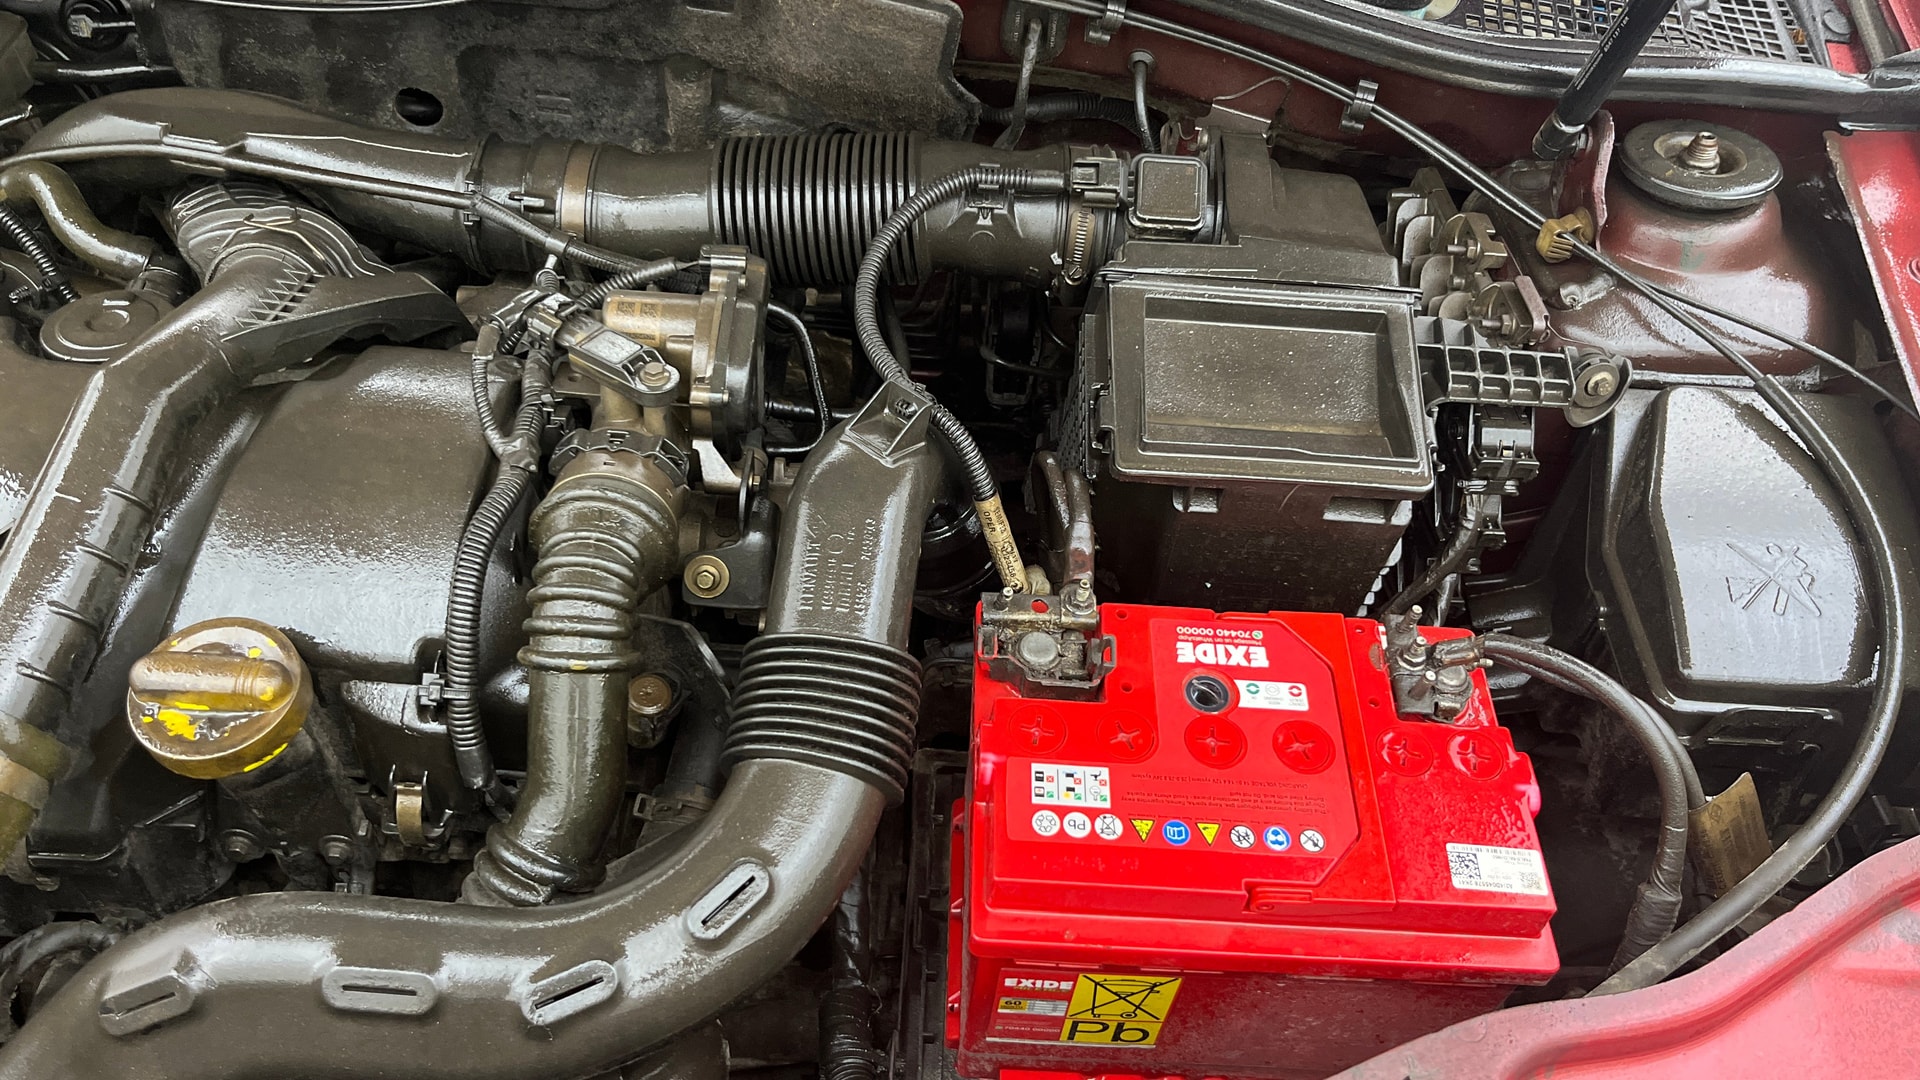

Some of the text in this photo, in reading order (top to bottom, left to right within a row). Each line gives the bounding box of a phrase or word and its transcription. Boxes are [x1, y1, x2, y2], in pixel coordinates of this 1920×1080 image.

[983, 511, 996, 534] OPER.
[1176, 626, 1251, 638] 70440 00000
[1175, 641, 1270, 668] EXIDE
[1068, 819, 1086, 830] Pb
[1004, 978, 1074, 990] EXIDE
[1067, 1020, 1150, 1043] Pb
